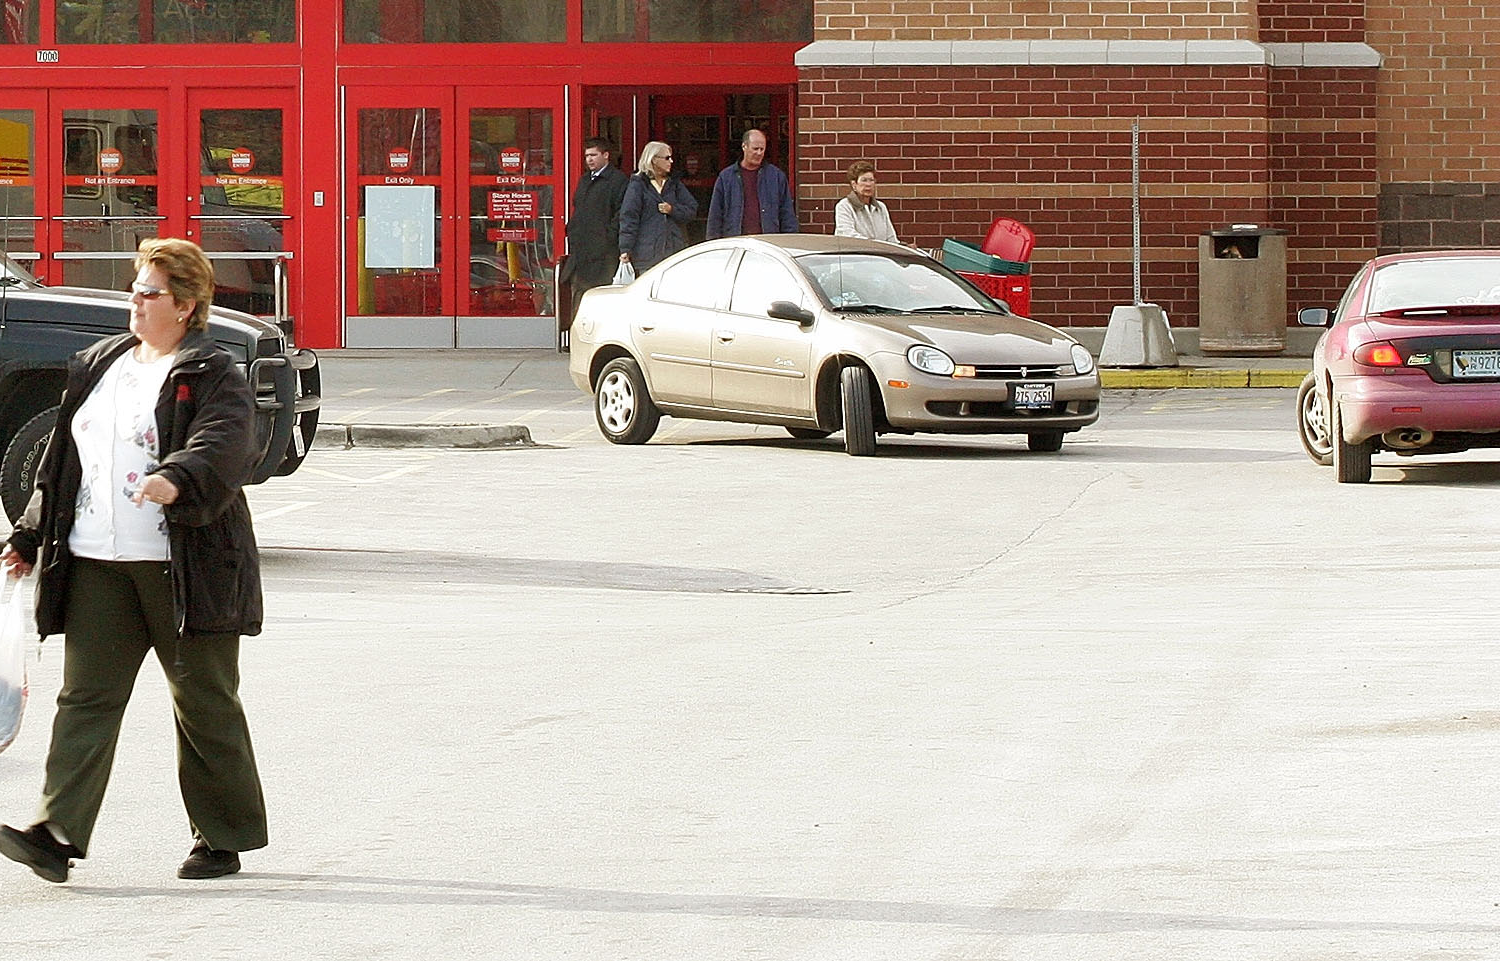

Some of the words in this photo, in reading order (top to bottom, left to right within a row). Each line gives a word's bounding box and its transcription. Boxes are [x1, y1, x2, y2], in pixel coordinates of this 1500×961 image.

[38, 50, 58, 62] 7000
[385, 176, 398, 184] Exit
[399, 176, 414, 185] Only
[510, 176, 525, 185] Only
